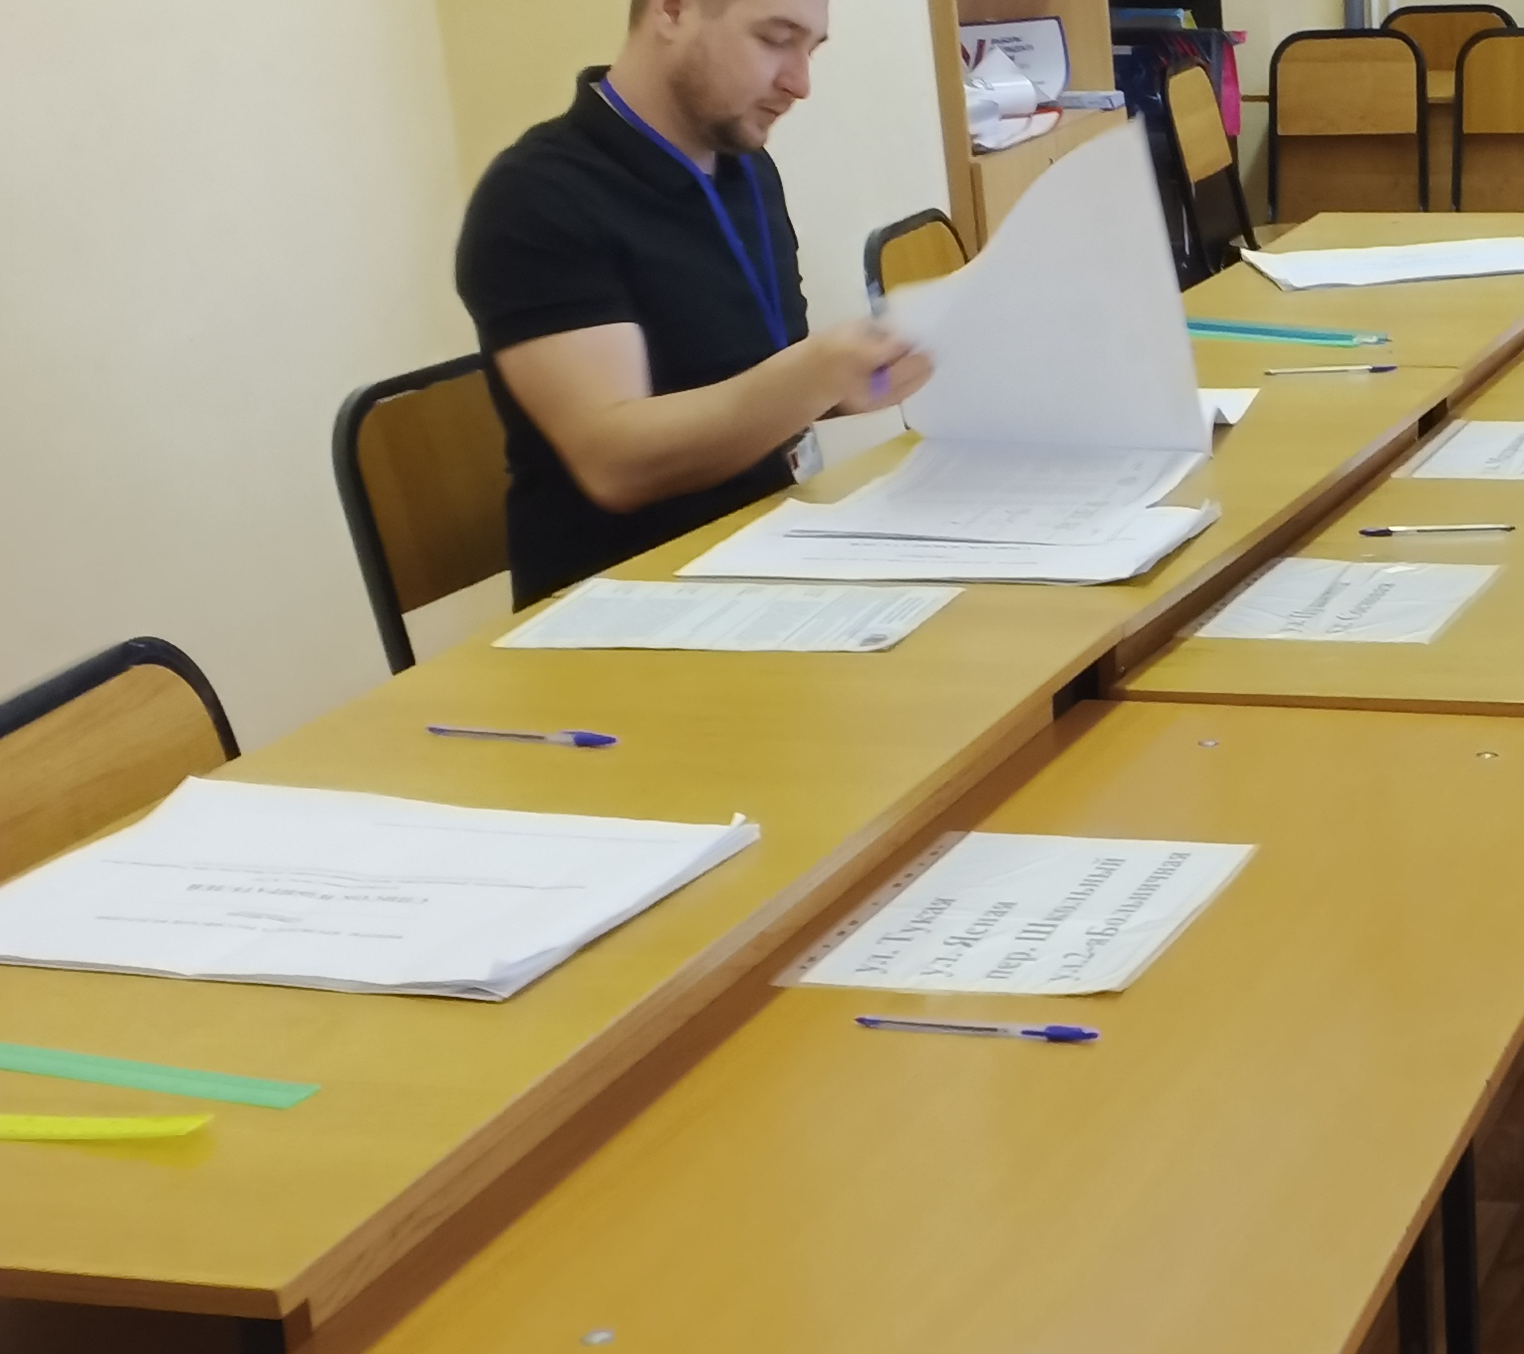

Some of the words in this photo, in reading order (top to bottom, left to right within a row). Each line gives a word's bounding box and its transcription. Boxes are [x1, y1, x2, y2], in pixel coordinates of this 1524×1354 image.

[876, 897, 958, 944] Тукая
[919, 953, 963, 978] ул.
[943, 901, 1018, 948] Ясная
[985, 947, 1037, 979] пер.
[1015, 857, 1126, 942] Школьный
[855, 950, 900, 975] ул.
